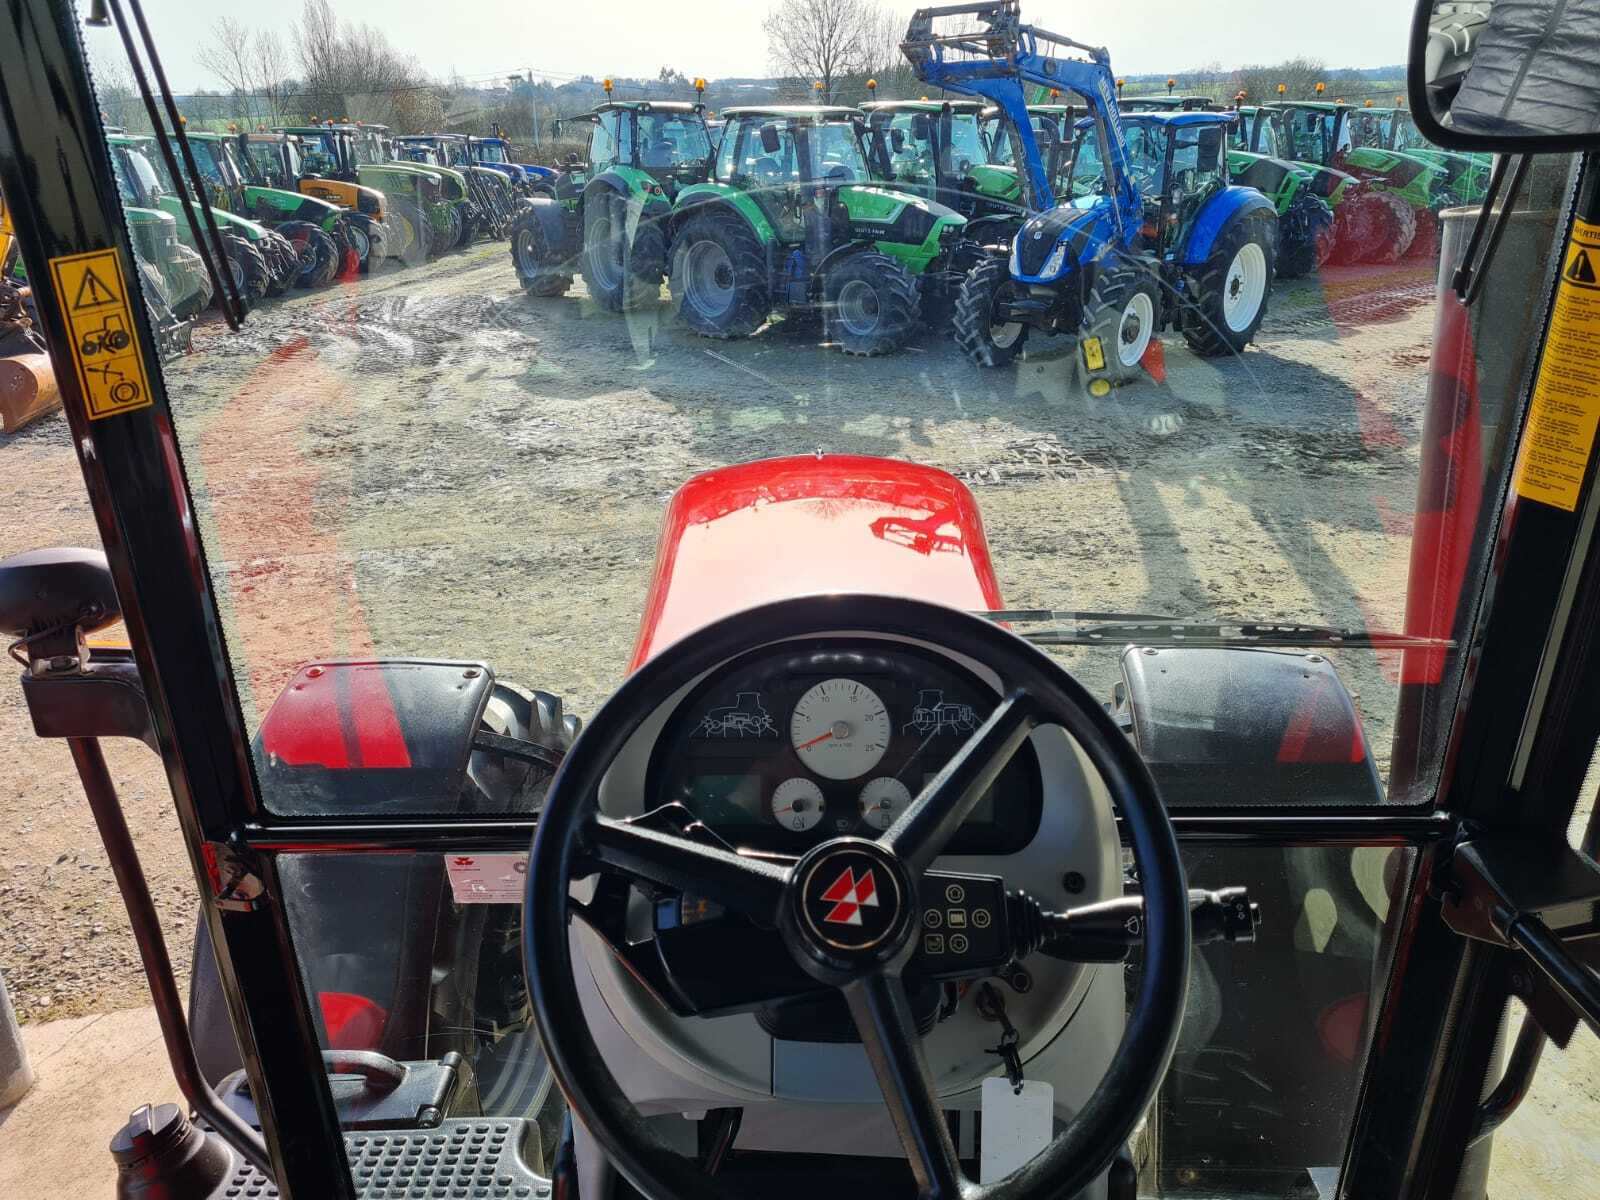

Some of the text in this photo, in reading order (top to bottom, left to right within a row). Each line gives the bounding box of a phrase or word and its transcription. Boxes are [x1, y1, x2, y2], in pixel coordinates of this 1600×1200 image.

[1108, 101, 1125, 147] HOLLAND
[864, 714, 874, 722] 20
[864, 743, 874, 752] 25
